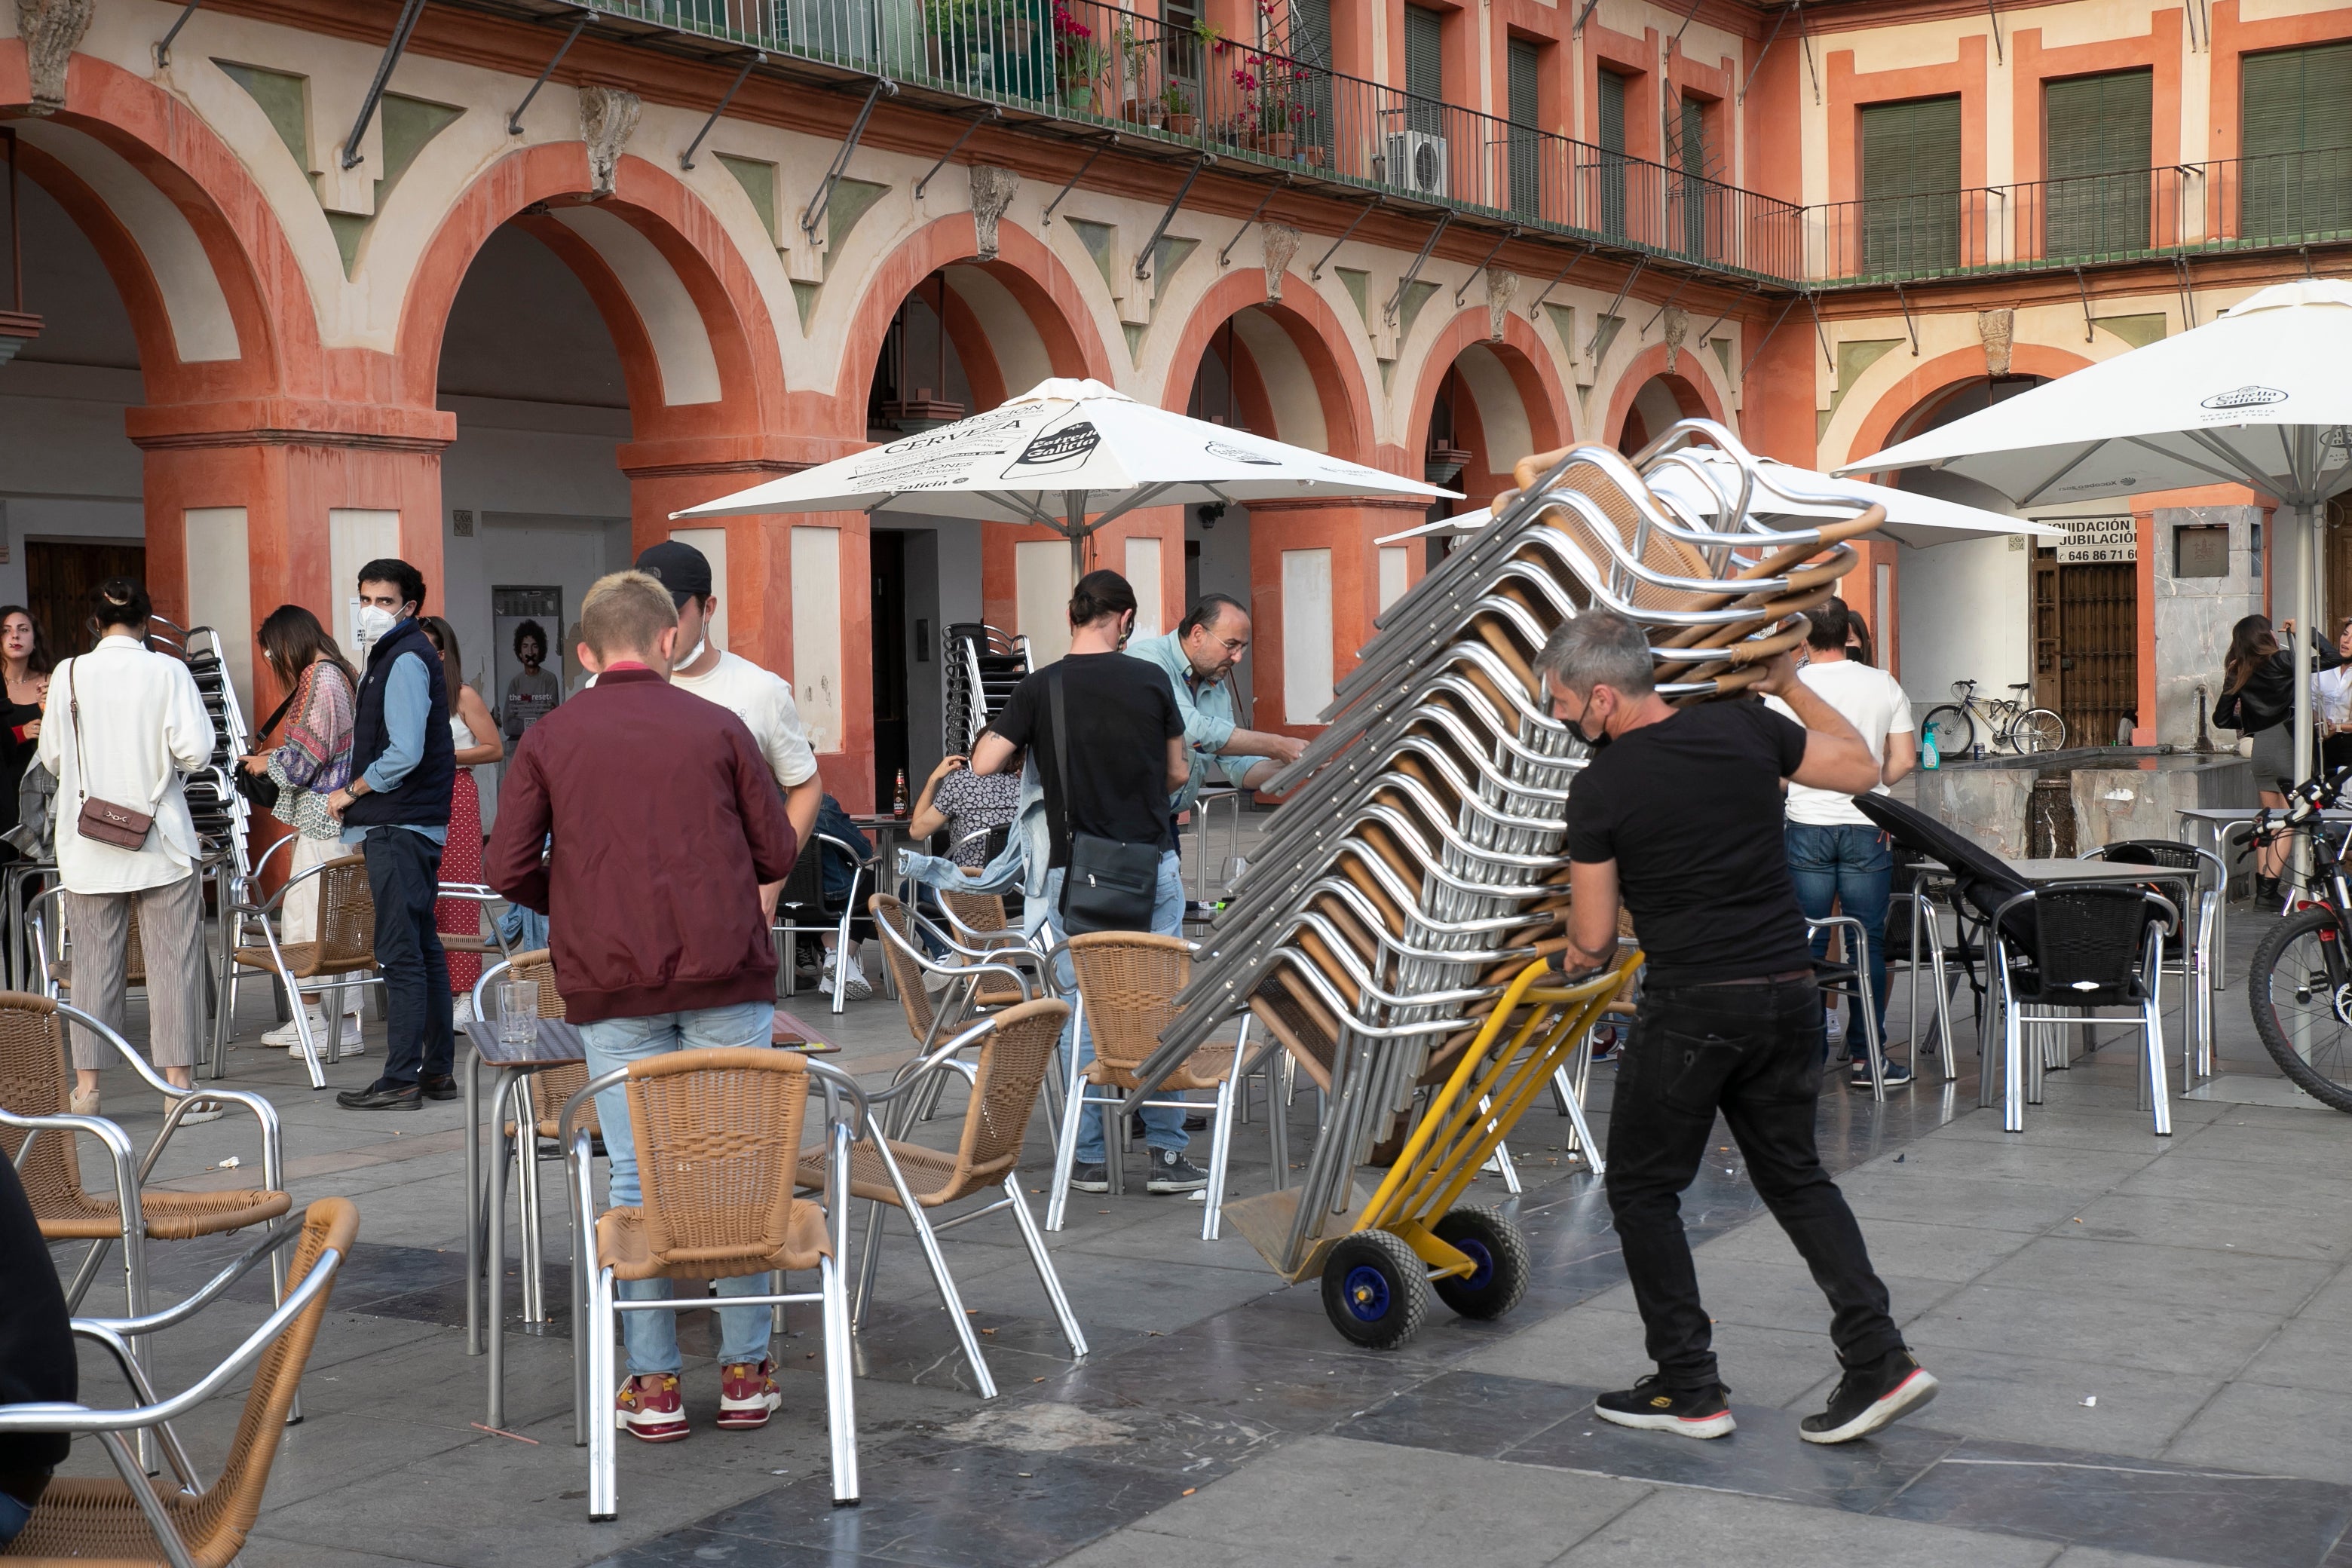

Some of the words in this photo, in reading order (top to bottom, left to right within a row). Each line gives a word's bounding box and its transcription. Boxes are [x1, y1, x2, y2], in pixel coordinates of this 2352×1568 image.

[2216, 397, 2271, 406] Galicia
[2217, 391, 2277, 400] Estrella
[884, 420, 1021, 454] CERVEZA
[1027, 438, 1088, 458] Galicia
[857, 461, 974, 485] GENERACIONES
[2069, 551, 2089, 561] 646
[2093, 550, 2106, 559] 86
[2110, 550, 2123, 559] 71
